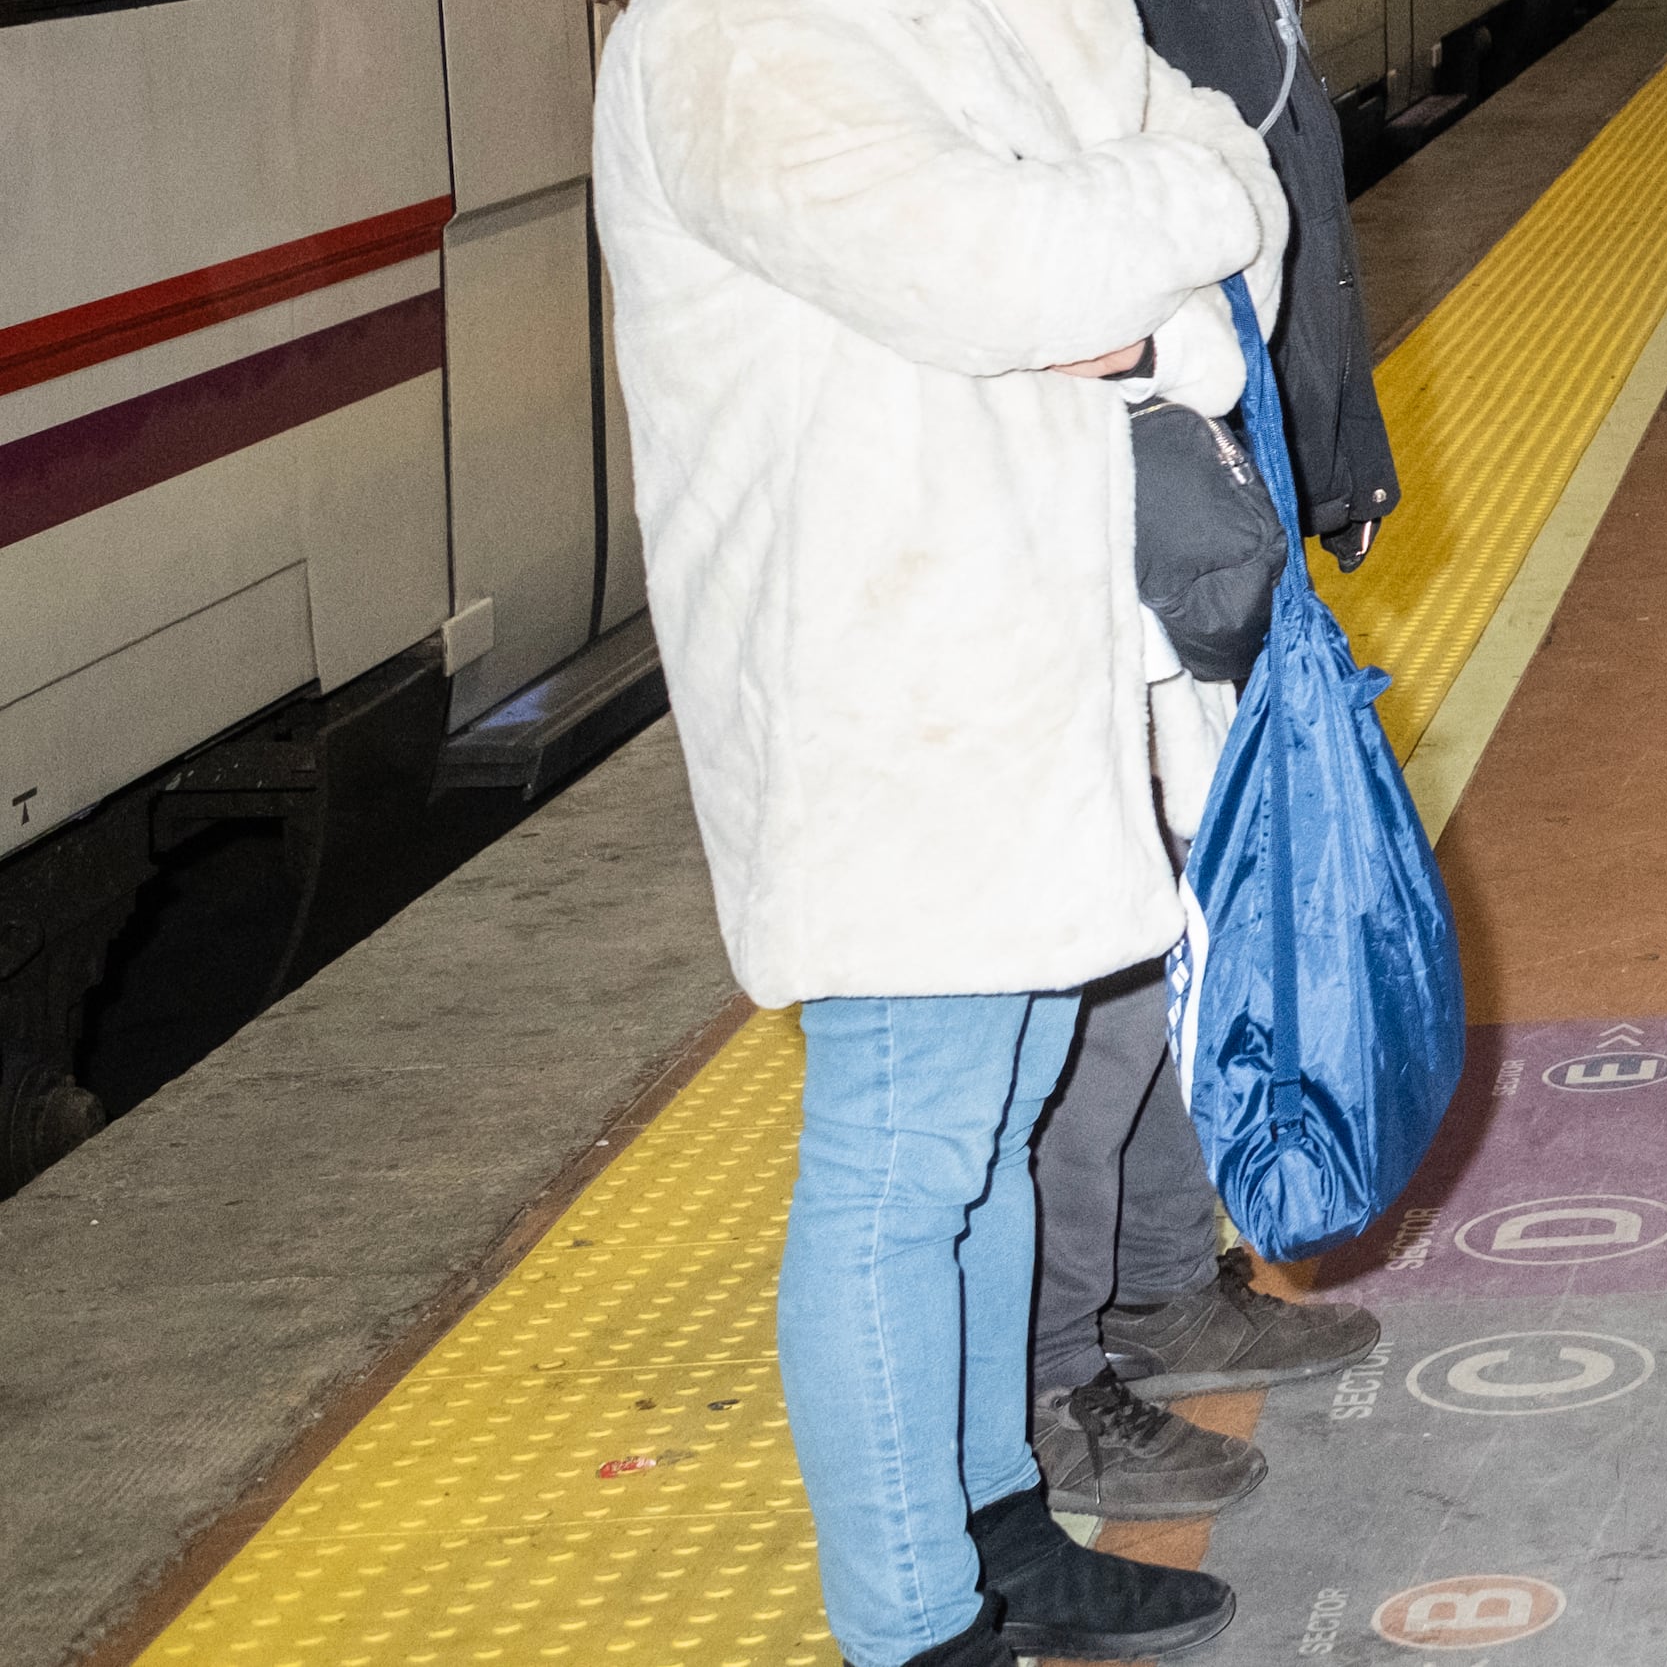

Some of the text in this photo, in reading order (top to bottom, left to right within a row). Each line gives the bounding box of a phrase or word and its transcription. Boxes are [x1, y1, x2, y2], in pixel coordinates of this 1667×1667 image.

[1491, 1058, 1659, 1097] SECTOR E
[1384, 1206, 1643, 1272] SECTOR D
[1447, 1346, 1616, 1399] C
[1299, 1586, 1533, 1656] SECTOR B
